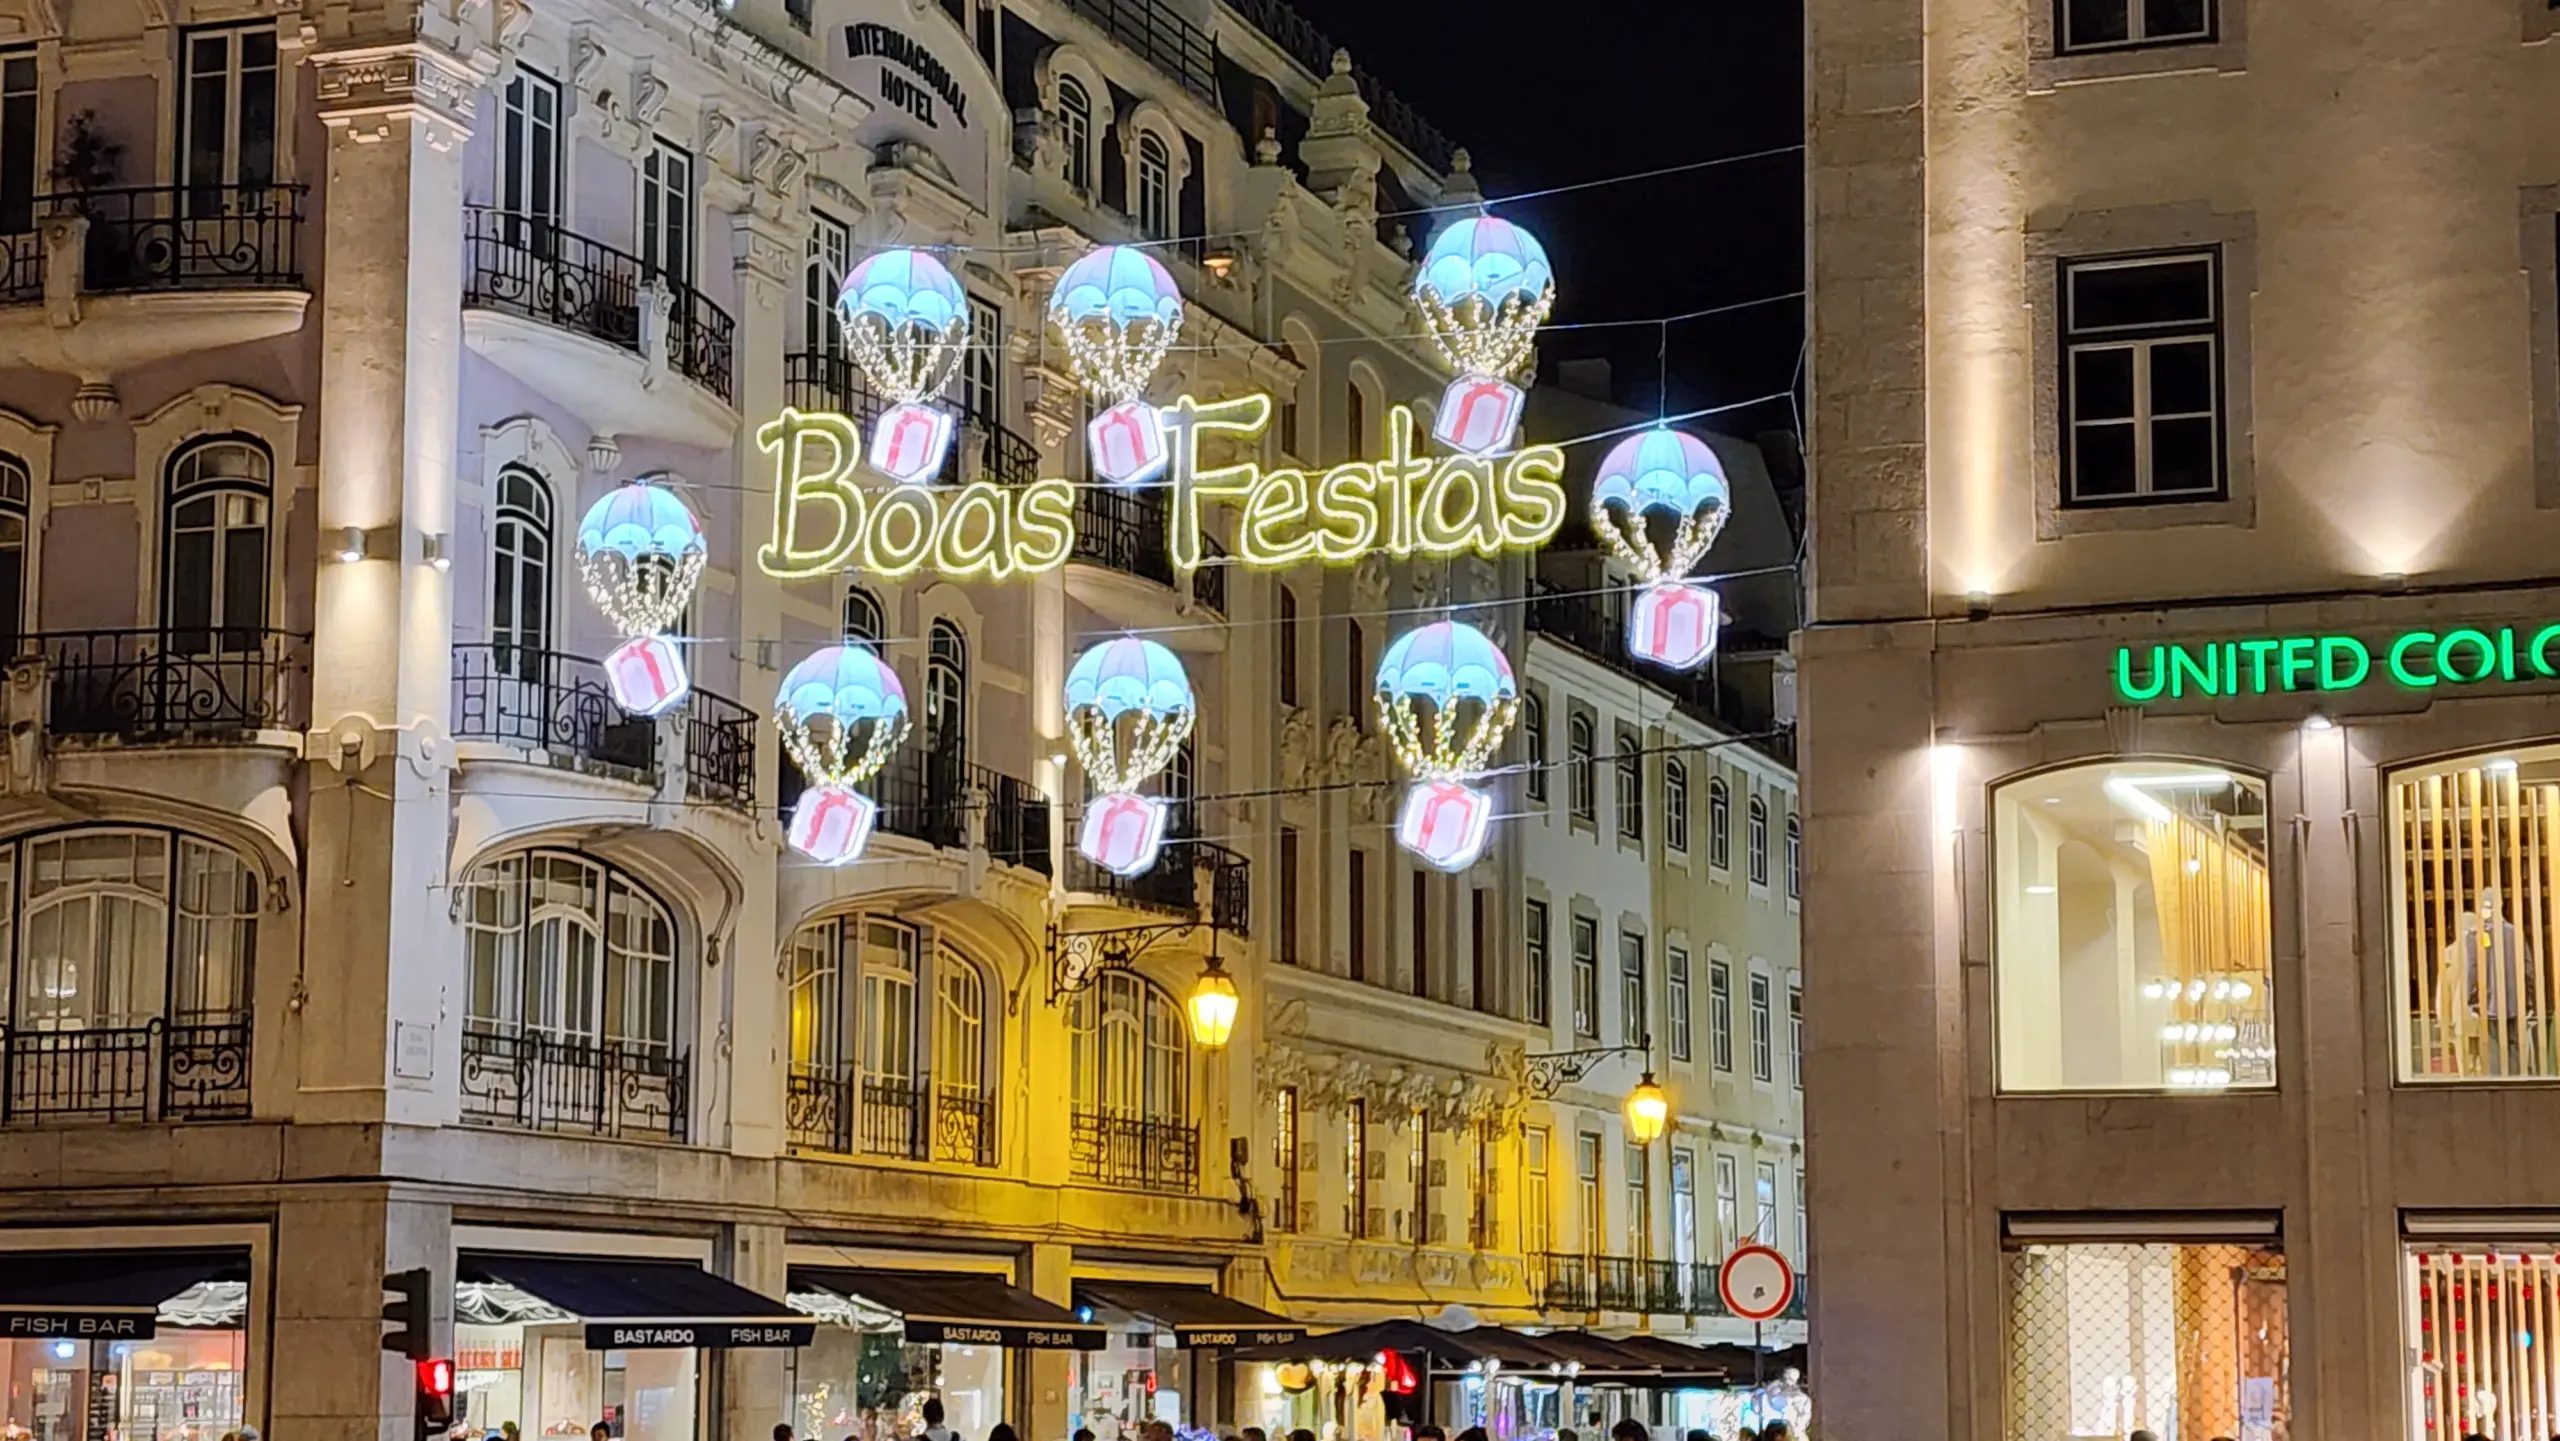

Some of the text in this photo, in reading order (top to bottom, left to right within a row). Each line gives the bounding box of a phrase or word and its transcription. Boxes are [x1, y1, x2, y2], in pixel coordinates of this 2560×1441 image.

[881, 66, 938, 129] HOTEL
[756, 394, 1567, 579] Boas Festas
[2117, 635, 2371, 701] UNITED
[10, 1317, 135, 1334] FISH BAR
[614, 1328, 791, 1344] BASTARDO FISH BAR
[943, 1327, 1002, 1343] BASTARDO
[1052, 1332, 1073, 1345] BAR
